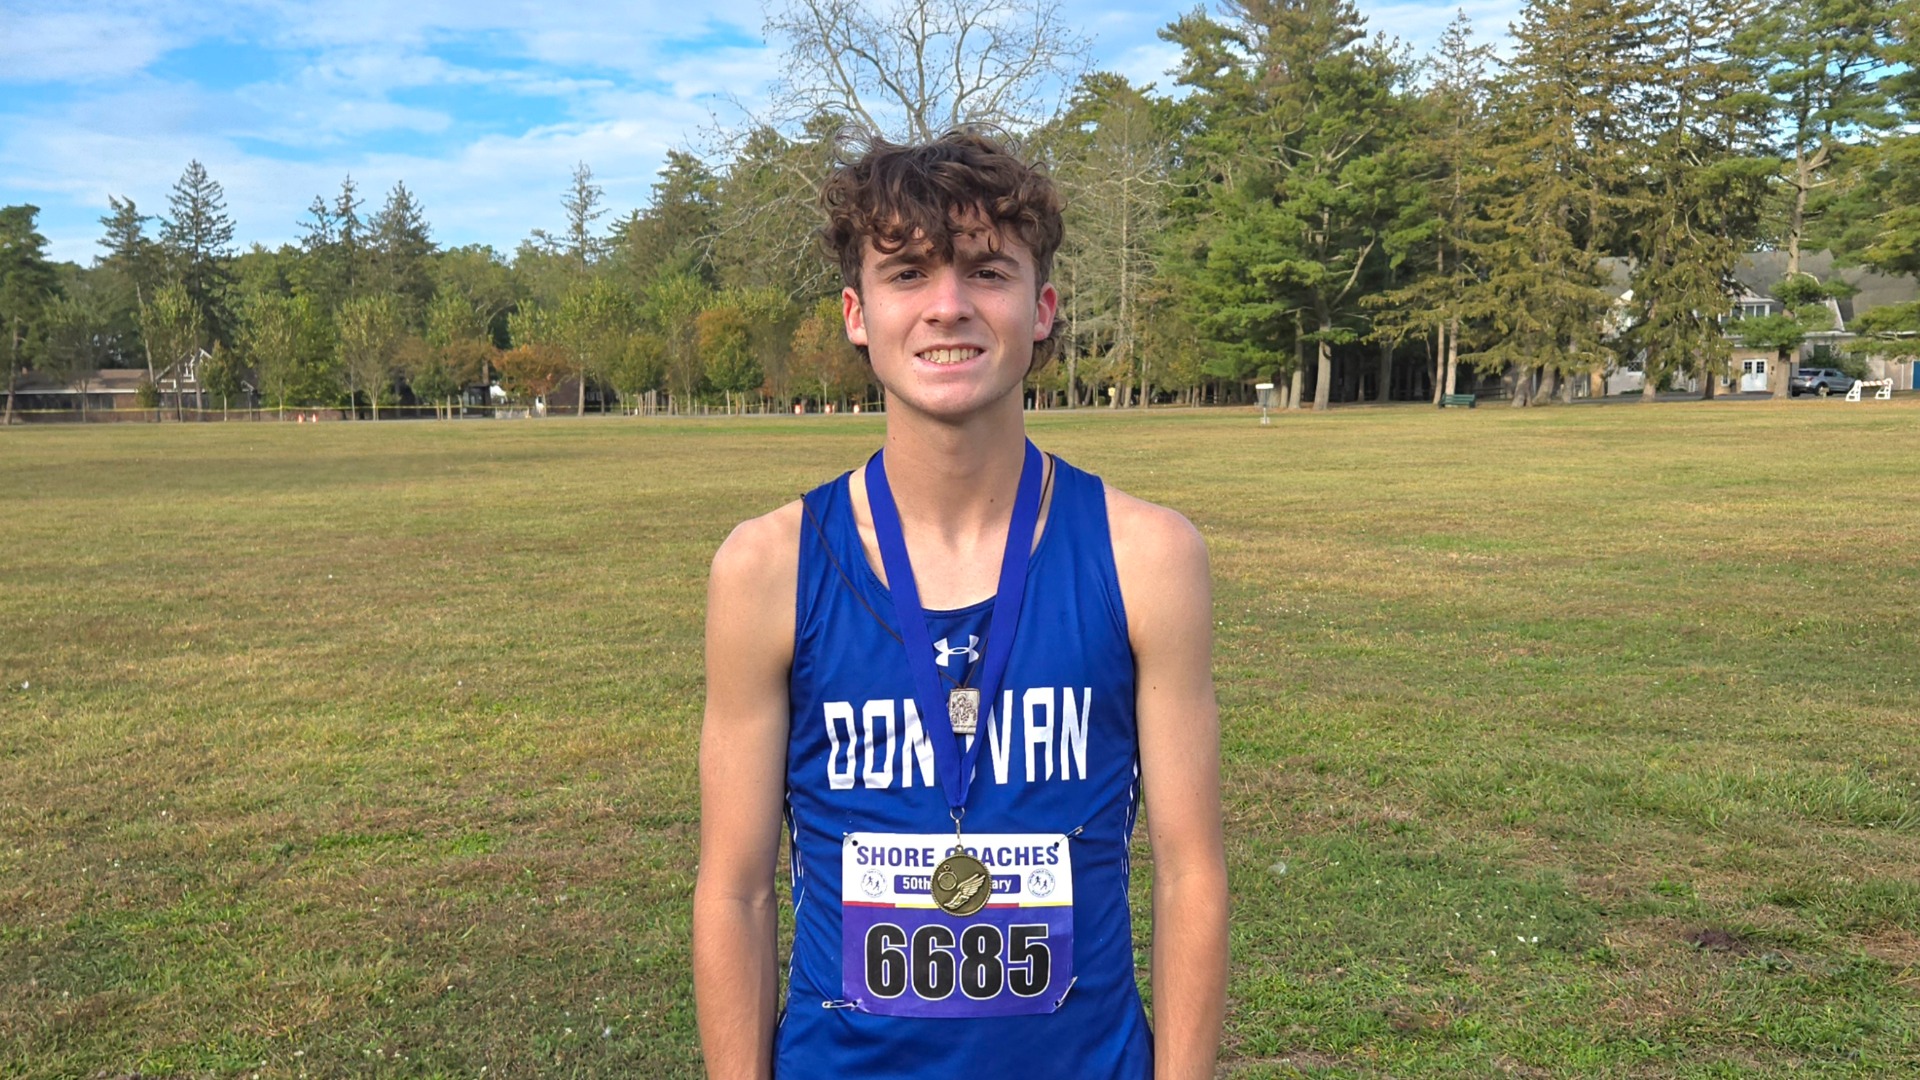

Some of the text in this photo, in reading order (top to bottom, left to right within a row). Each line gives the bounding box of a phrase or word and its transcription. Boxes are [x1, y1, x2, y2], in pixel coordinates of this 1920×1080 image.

[823, 687, 1092, 789] DONVAN
[856, 845, 935, 867] SHORE
[902, 876, 931, 890] 50th
[865, 923, 1051, 1001] 6685
